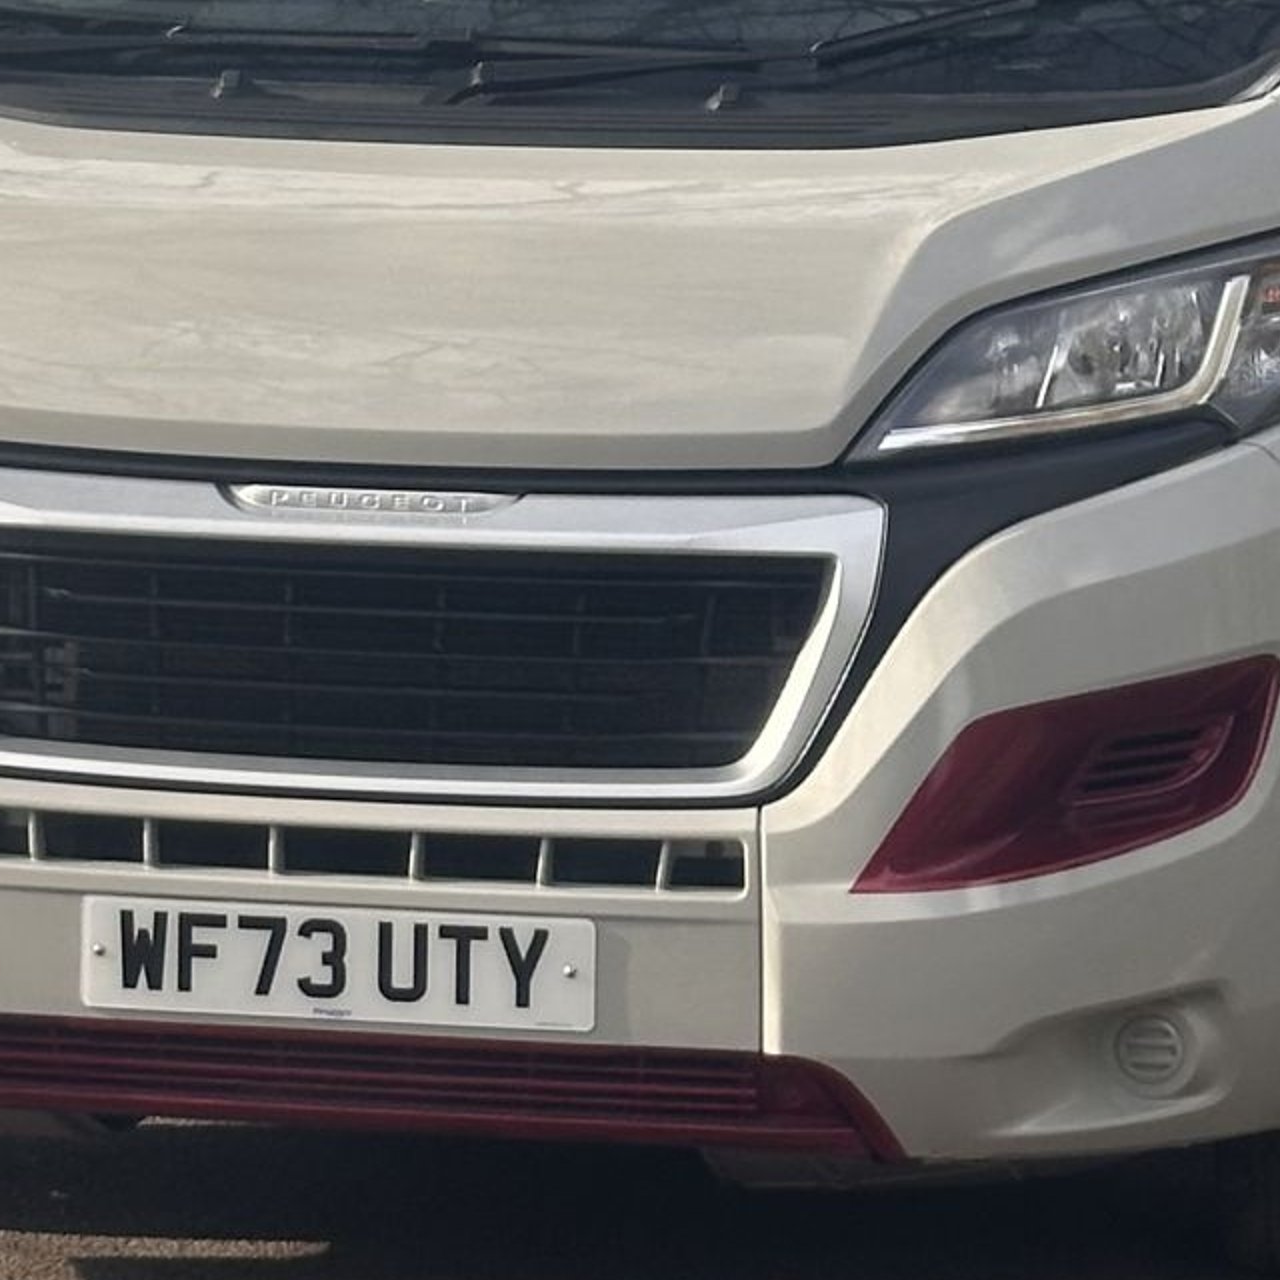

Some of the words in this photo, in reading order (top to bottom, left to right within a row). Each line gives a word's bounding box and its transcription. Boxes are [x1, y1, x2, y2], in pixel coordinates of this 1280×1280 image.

[271, 489, 471, 512] PEUGEOT
[120, 909, 348, 999] WF73
[377, 921, 550, 1008] UTY
